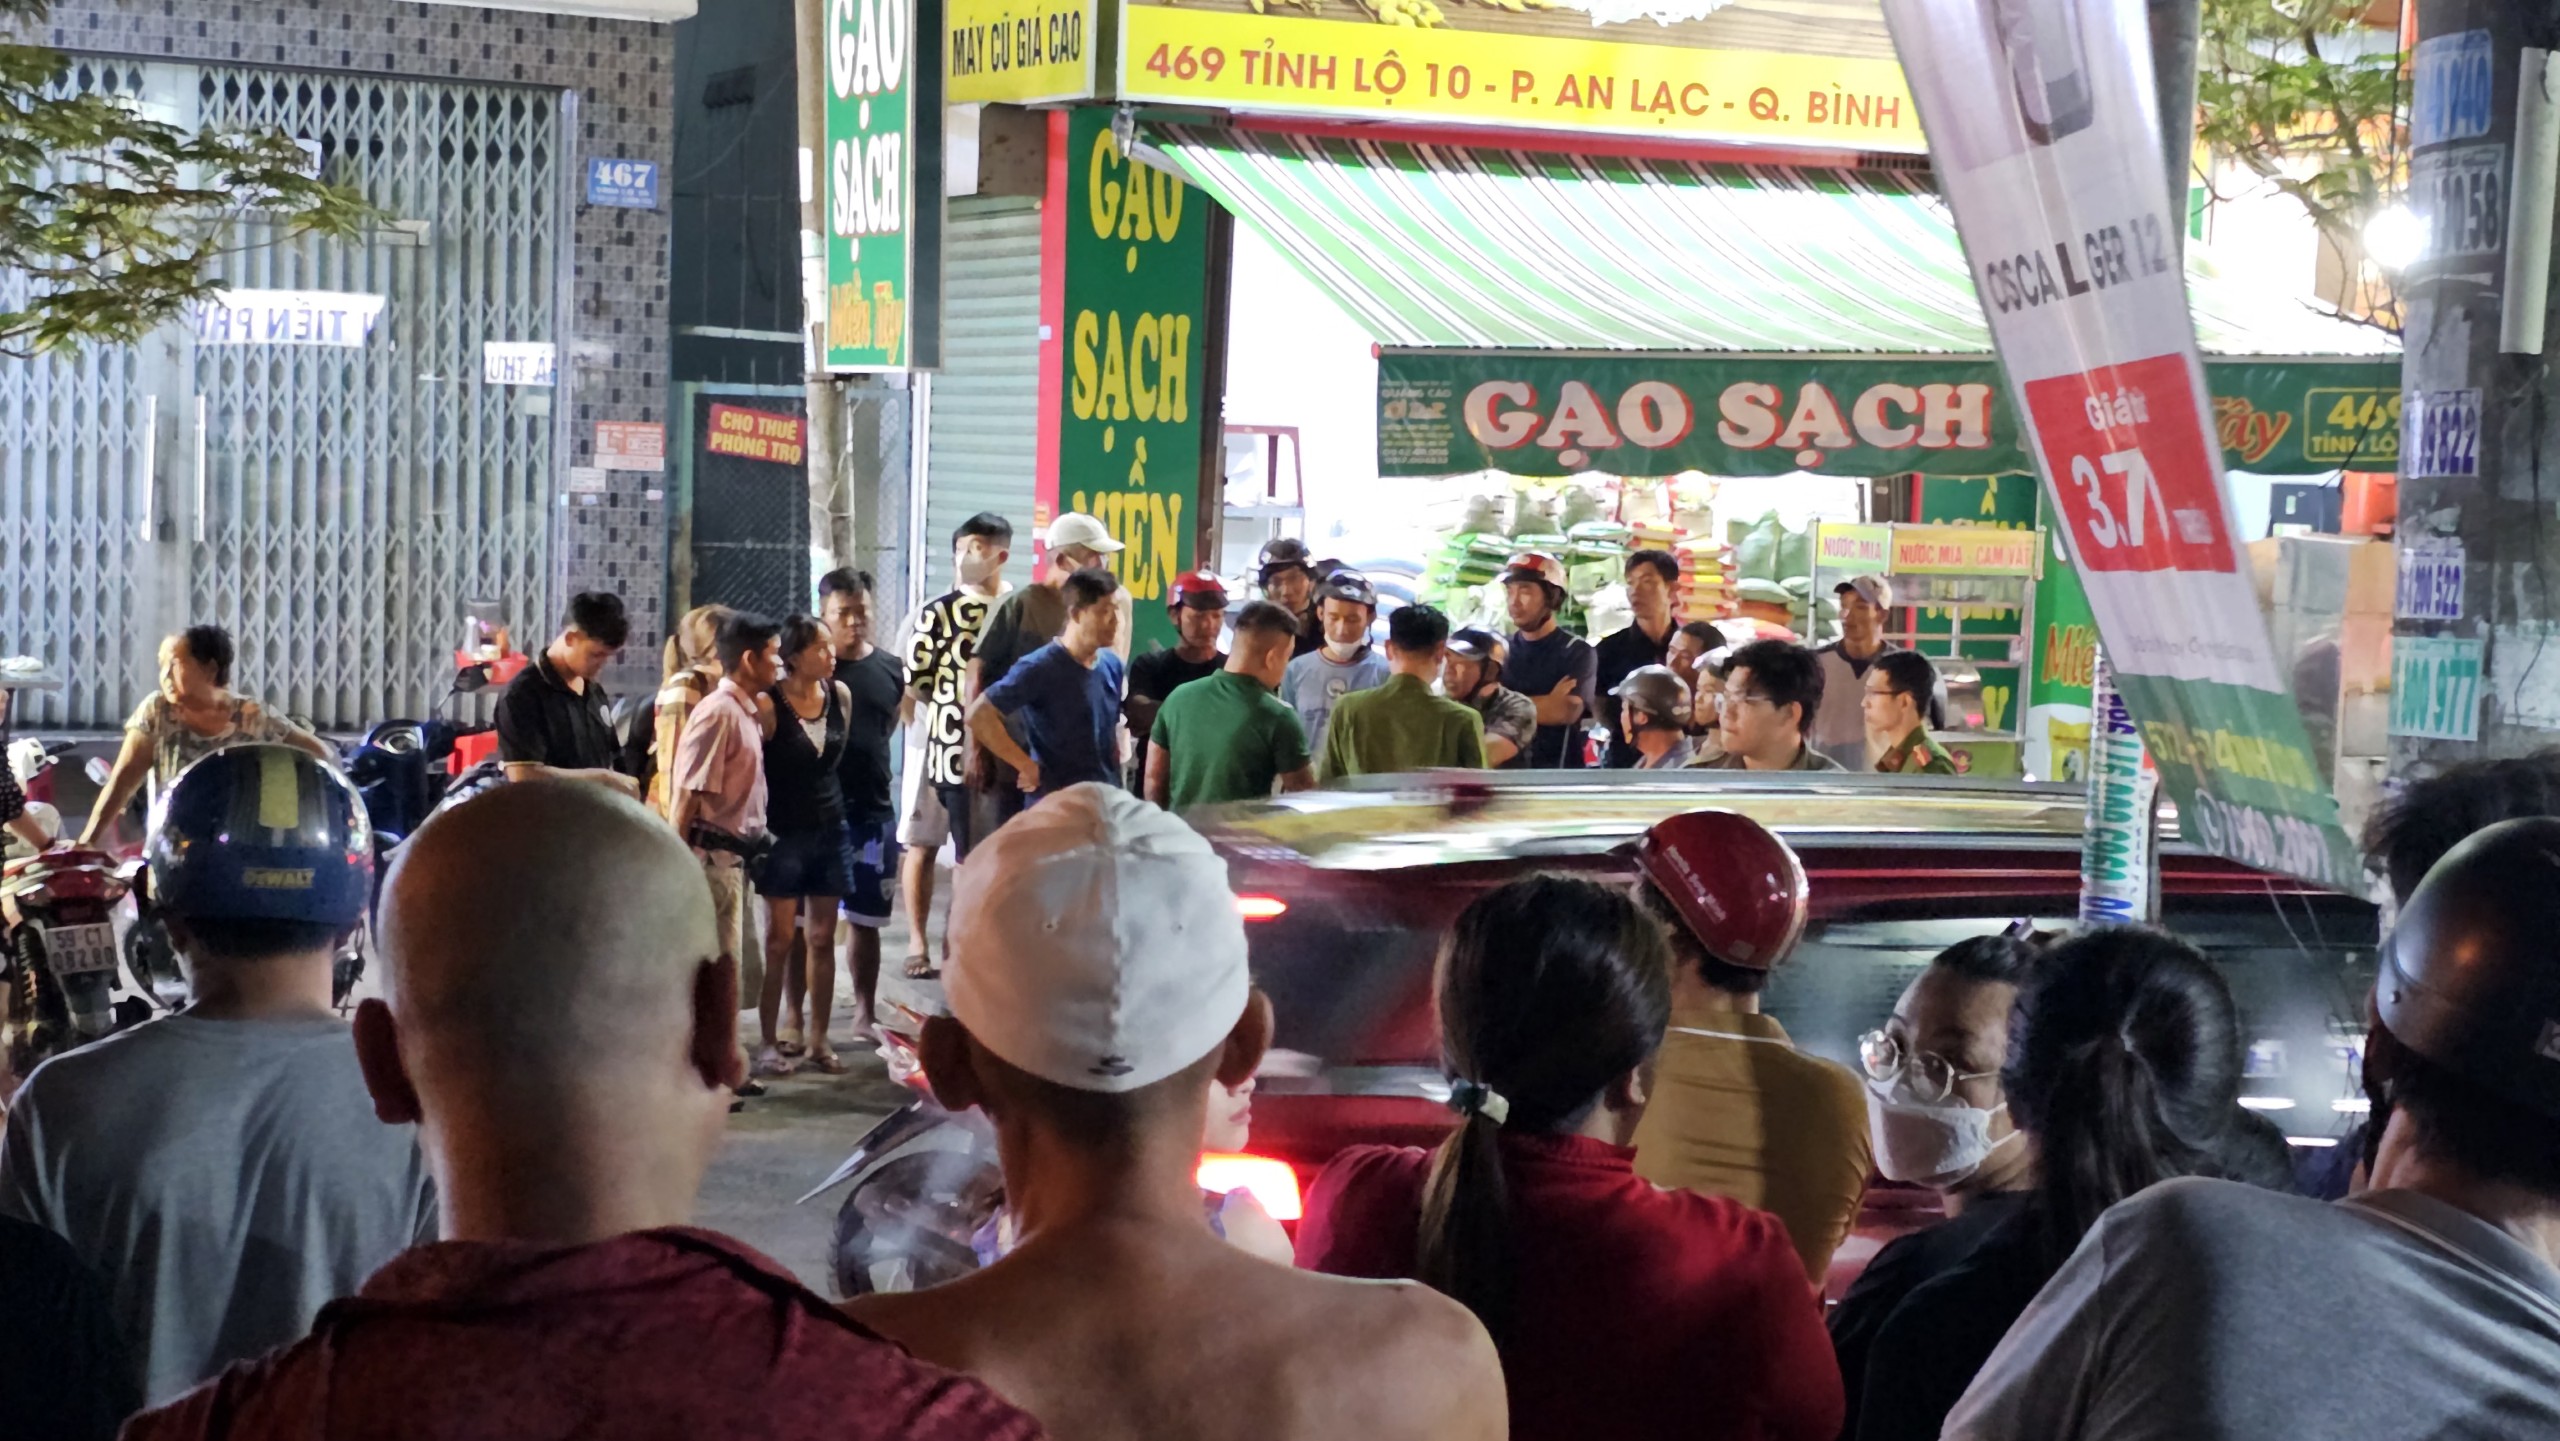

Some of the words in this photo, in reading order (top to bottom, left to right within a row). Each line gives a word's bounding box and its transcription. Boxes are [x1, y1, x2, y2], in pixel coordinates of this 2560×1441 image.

[953, 16, 984, 77] MÁY
[1017, 5, 1043, 68] GIÁ
[1050, 10, 1081, 64] CAO
[1146, 43, 1225, 82] 469
[1240, 38, 1337, 90] TỈNH
[1354, 49, 1406, 105] LỘ
[1426, 63, 1471, 99] 10
[1511, 69, 1538, 103] P.
[1555, 74, 1614, 110] AN
[1630, 79, 1709, 124] LẠC
[1748, 87, 1790, 122] Q.
[1807, 82, 1900, 128] BÌNH
[595, 161, 652, 188] 467
[833, 132, 901, 263] SẠCH
[1089, 128, 1184, 273] GẠO
[720, 411, 754, 433] CHO
[757, 416, 798, 440] THUÊ
[1072, 309, 1191, 453] SẠCH
[1463, 379, 1694, 468] GẠO
[1717, 381, 1993, 467] SẠCH
[710, 431, 767, 457] PHÒNG
[771, 441, 801, 465] TRỌ
